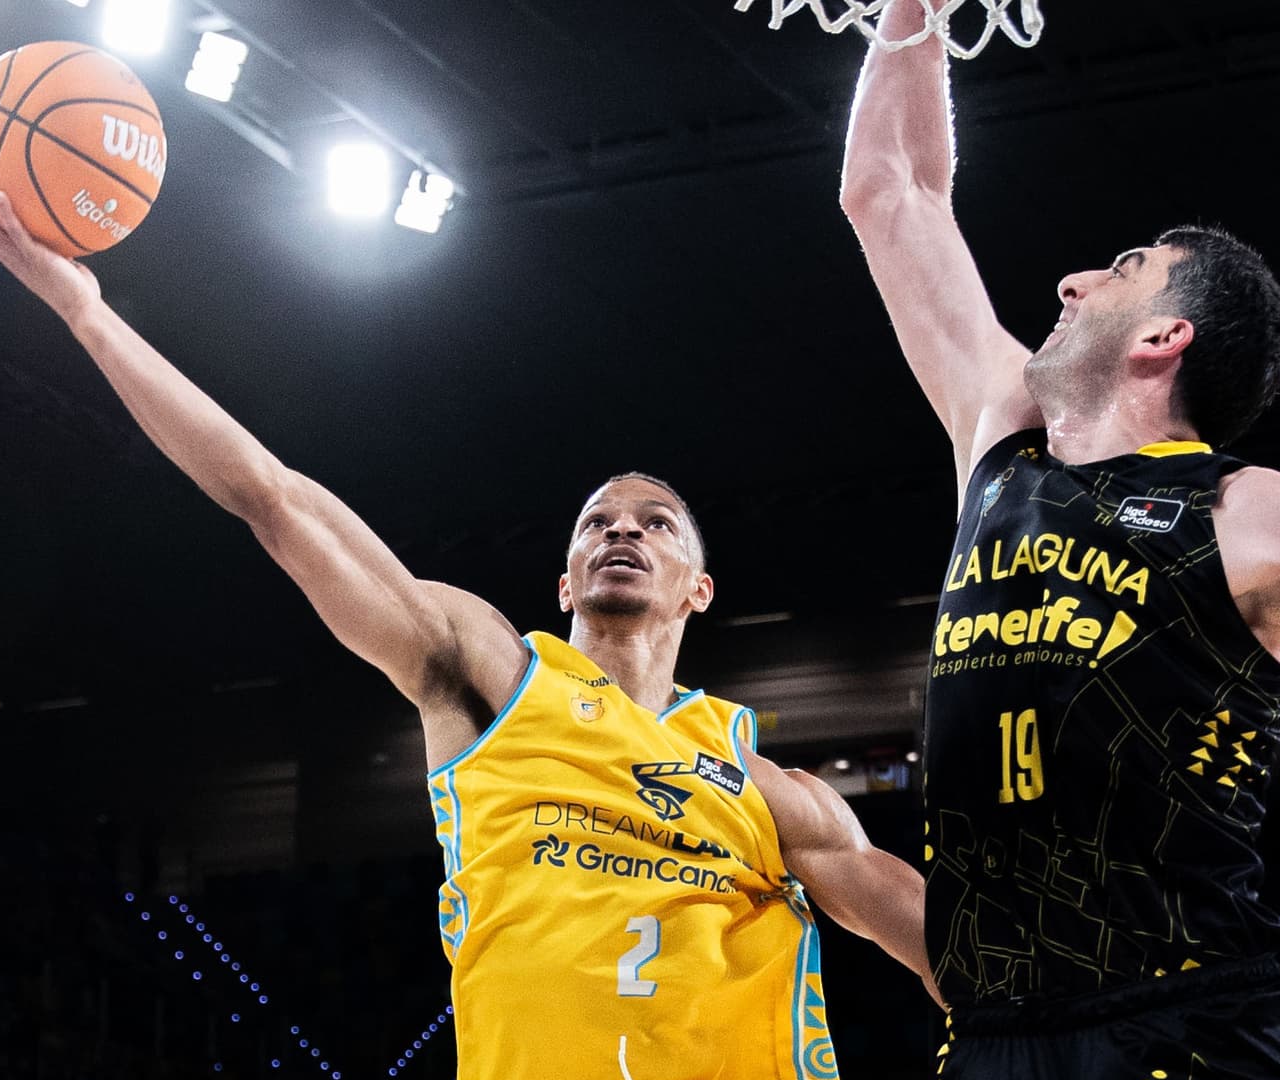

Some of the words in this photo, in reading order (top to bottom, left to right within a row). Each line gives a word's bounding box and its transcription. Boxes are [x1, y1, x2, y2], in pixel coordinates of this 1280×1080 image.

[1119, 515, 1171, 529] endesa
[1124, 505, 1149, 517] liga
[946, 545, 982, 593] LA
[991, 533, 1150, 606] LAGUNA
[932, 652, 1007, 678] despierta
[699, 756, 721, 773] liga
[998, 708, 1045, 804] 19
[698, 767, 741, 793] endesa
[576, 845, 737, 895] GranCana
[616, 915, 662, 998] 2
